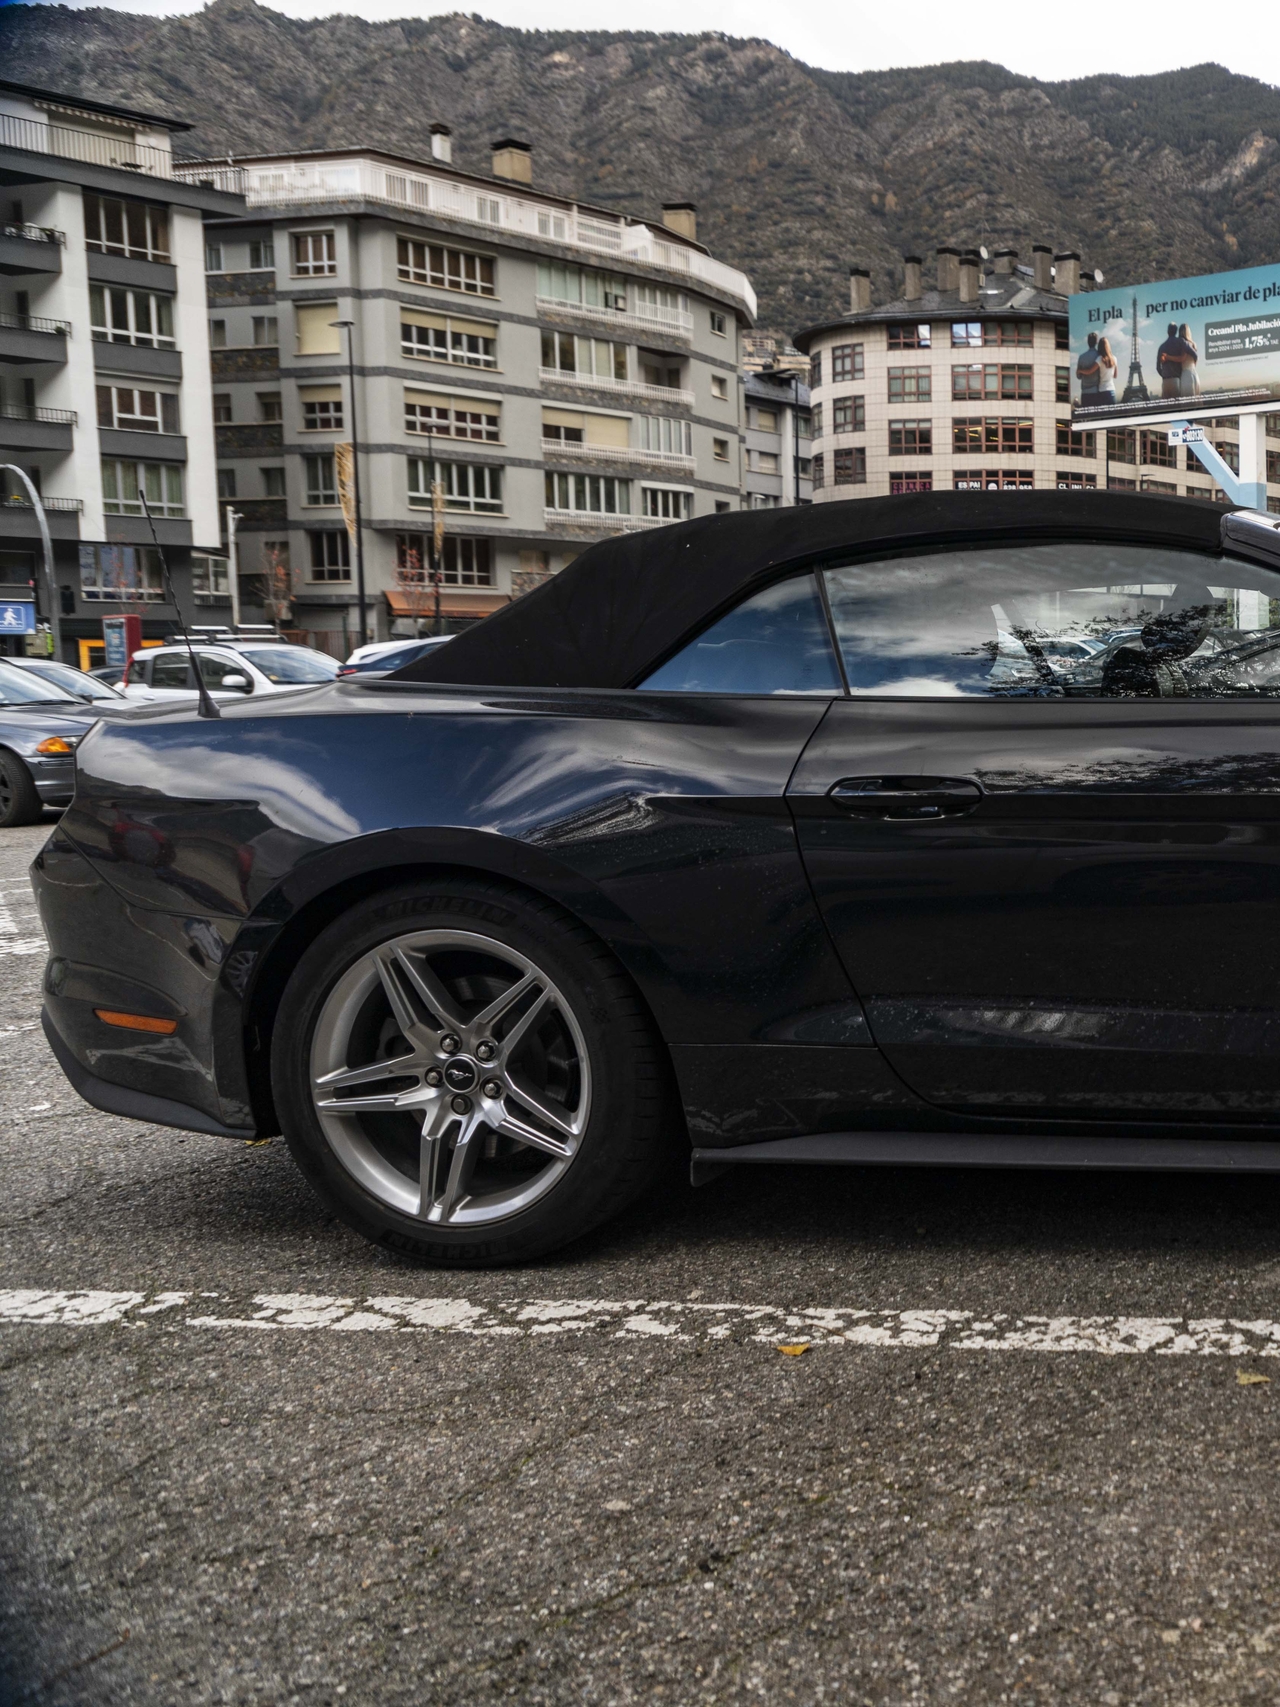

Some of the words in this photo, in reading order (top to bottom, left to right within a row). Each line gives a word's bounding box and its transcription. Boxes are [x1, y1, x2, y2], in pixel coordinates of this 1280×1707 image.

[1087, 307, 1101, 323] El
[1103, 306, 1123, 323] pla
[1145, 299, 1167, 318] per
[1170, 297, 1188, 311] no
[1189, 291, 1242, 307] canviar
[1243, 286, 1261, 301] de
[1208, 325, 1234, 336] Creand
[1235, 325, 1247, 333] Pla
[1247, 318, 1280, 331] Jubilació
[385, 896, 510, 925] MICHELIN
